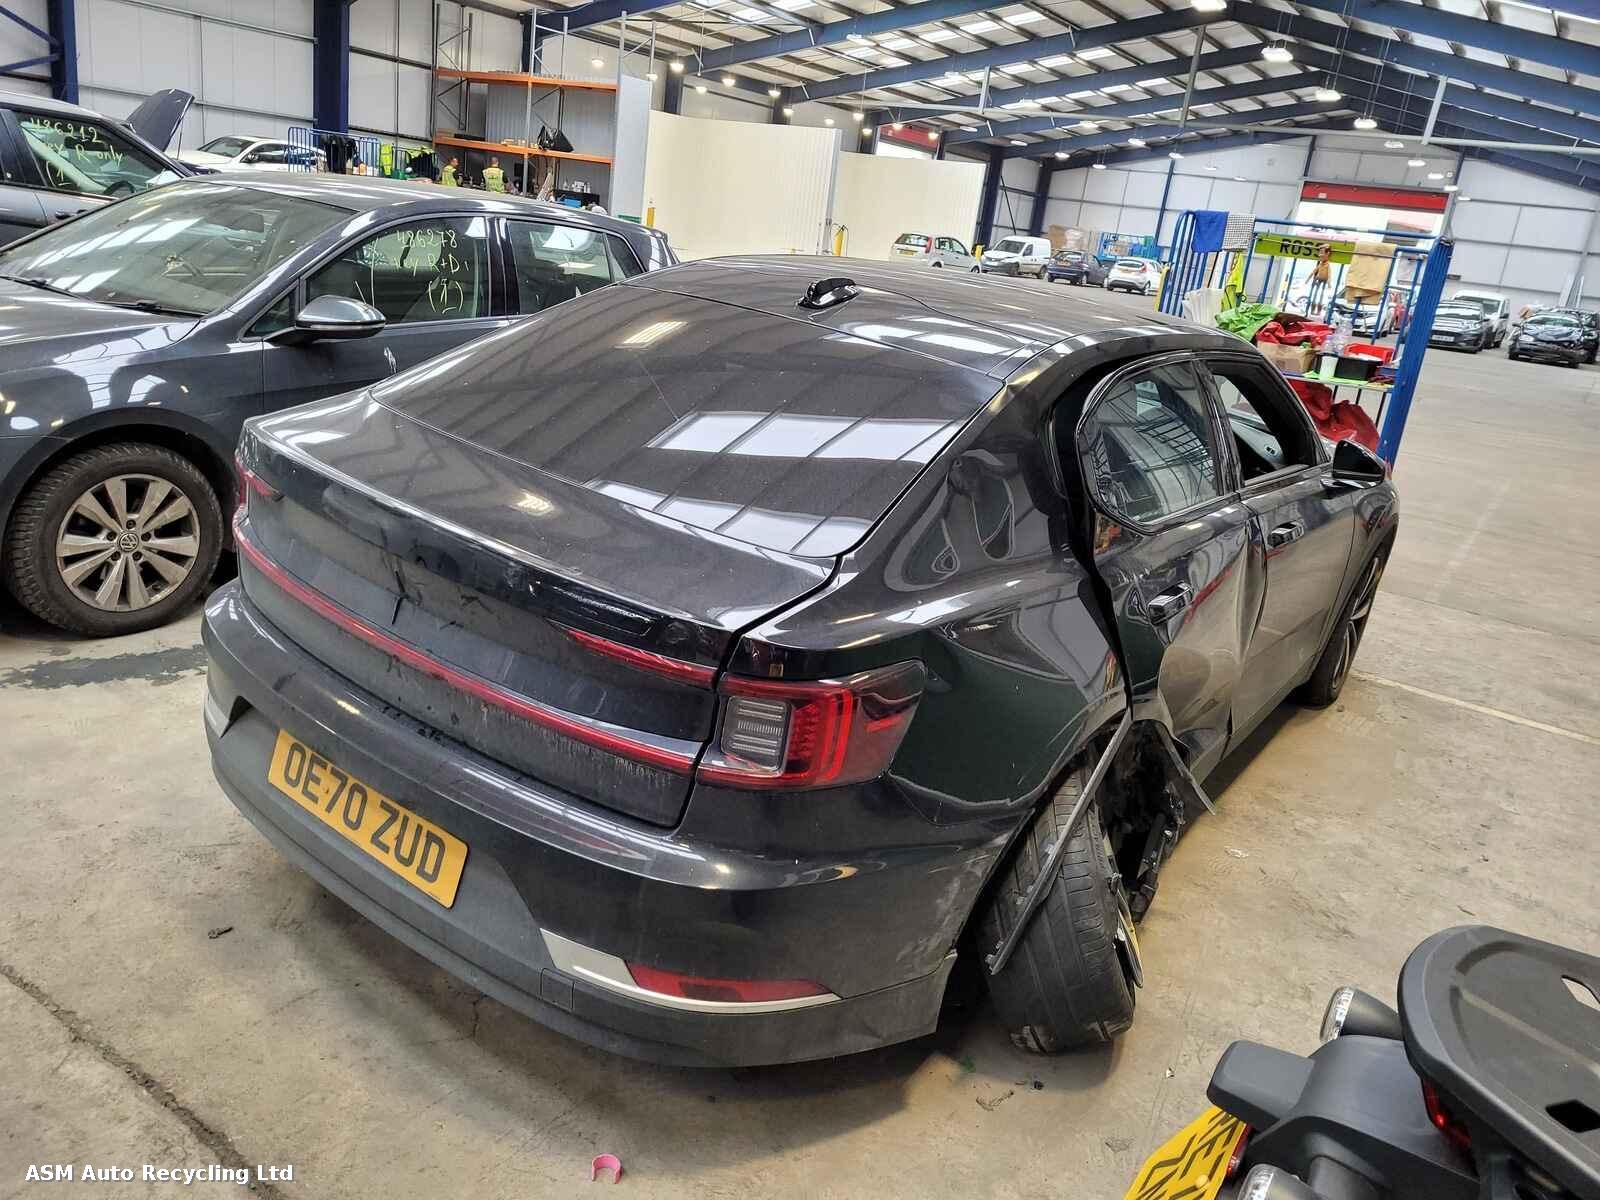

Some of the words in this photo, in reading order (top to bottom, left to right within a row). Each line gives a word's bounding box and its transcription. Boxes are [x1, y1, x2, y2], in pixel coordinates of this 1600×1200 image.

[96, 145, 122, 167] only
[283, 742, 368, 831] OE70
[370, 800, 446, 884] ZUD
